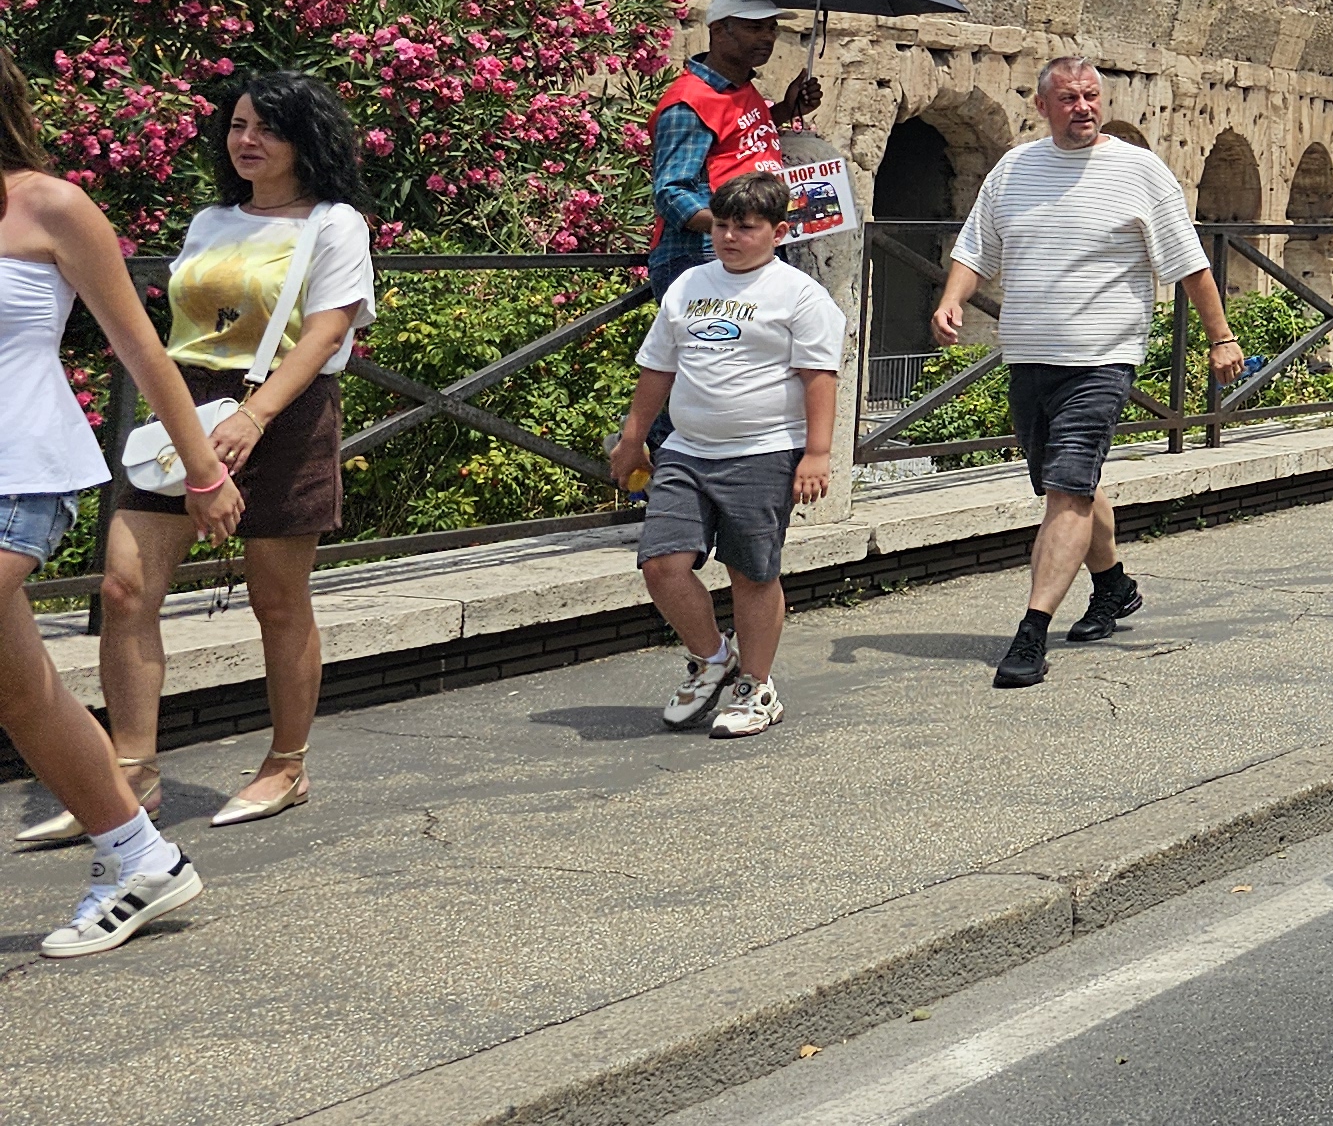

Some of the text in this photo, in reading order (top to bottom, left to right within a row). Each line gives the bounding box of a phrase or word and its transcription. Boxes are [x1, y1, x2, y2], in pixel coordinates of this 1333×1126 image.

[737, 107, 761, 130] STAFF
[787, 165, 816, 184] HOP
[818, 160, 842, 177] OFF
